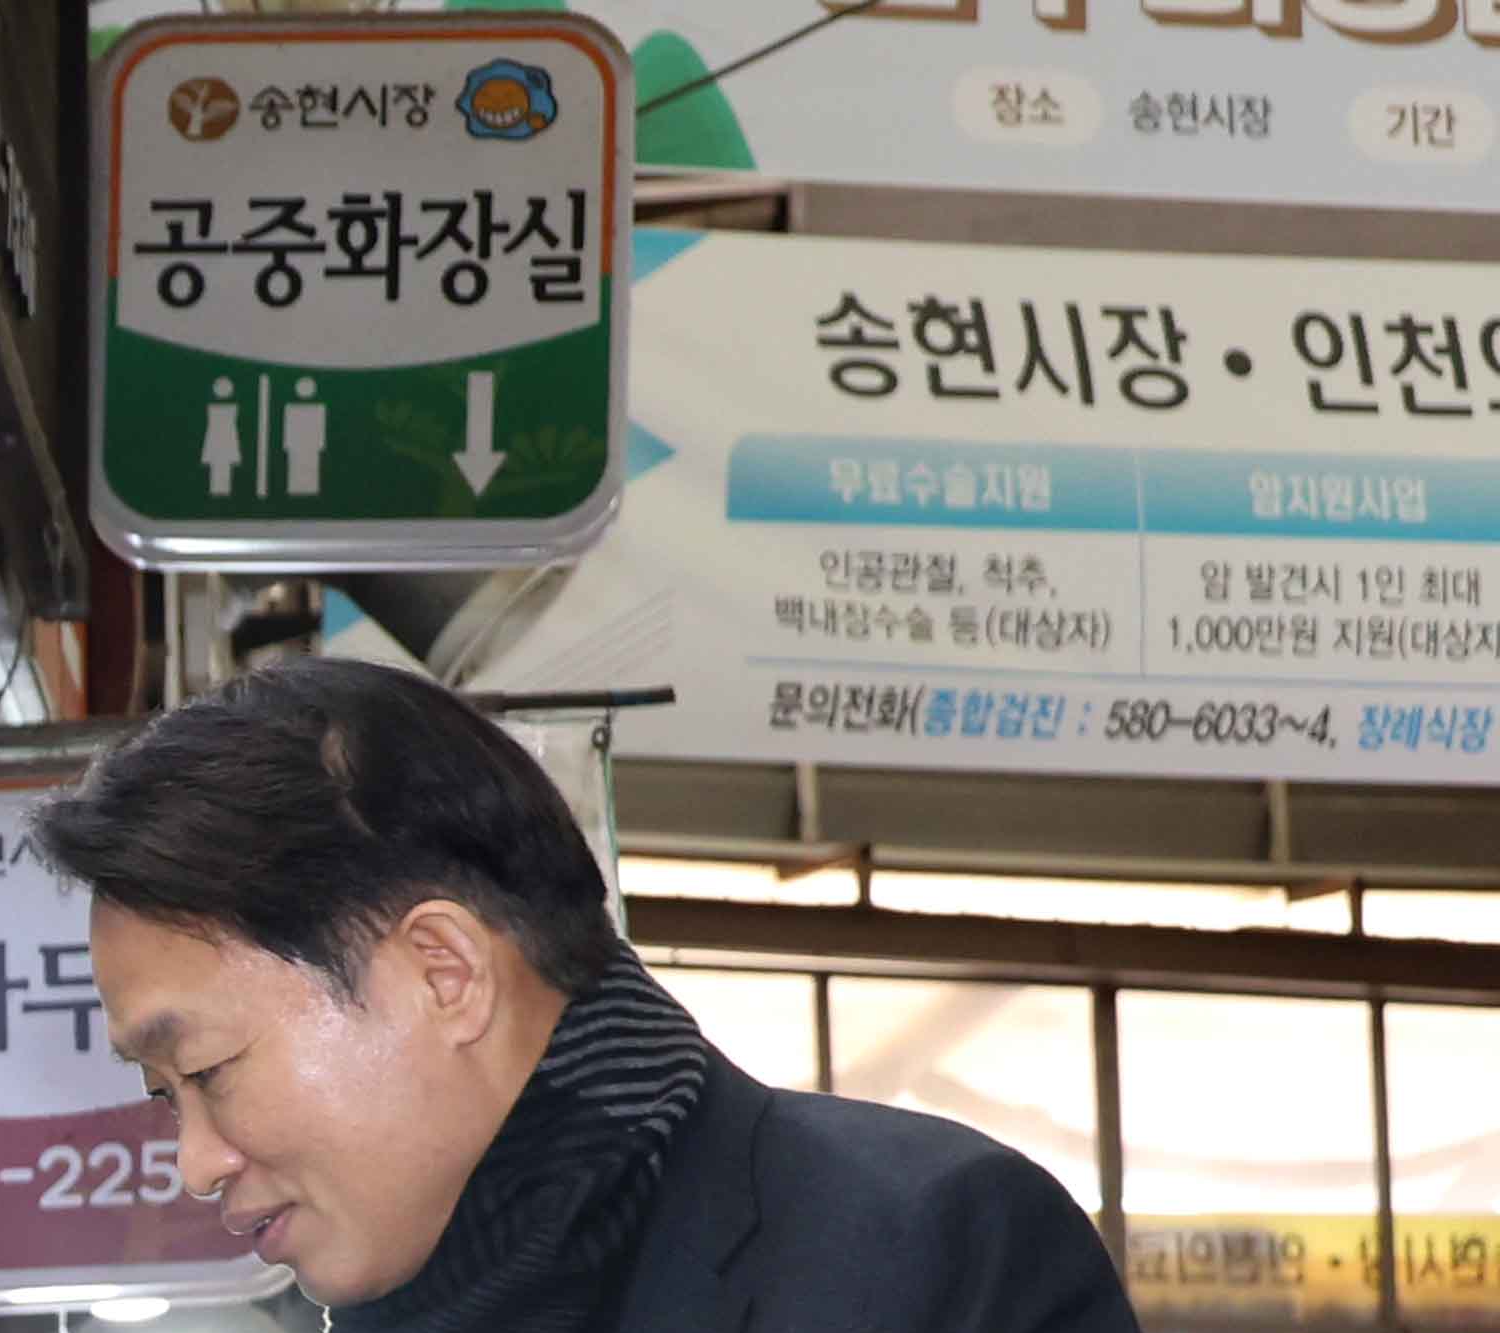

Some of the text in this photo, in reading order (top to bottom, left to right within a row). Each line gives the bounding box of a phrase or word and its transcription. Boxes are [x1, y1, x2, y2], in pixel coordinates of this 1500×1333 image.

[248, 83, 436, 132] 송현시장
[991, 83, 1457, 148] 장소 송현시장 기간
[134, 190, 587, 308] 공중화장실
[815, 291, 1190, 411] 송현시장
[828, 457, 1052, 512] 무료수술지원
[1249, 470, 1428, 522] 암지원사업
[1200, 560, 1483, 607] 암 발견시 1인 최대
[1356, 704, 1494, 754] 장례식장
